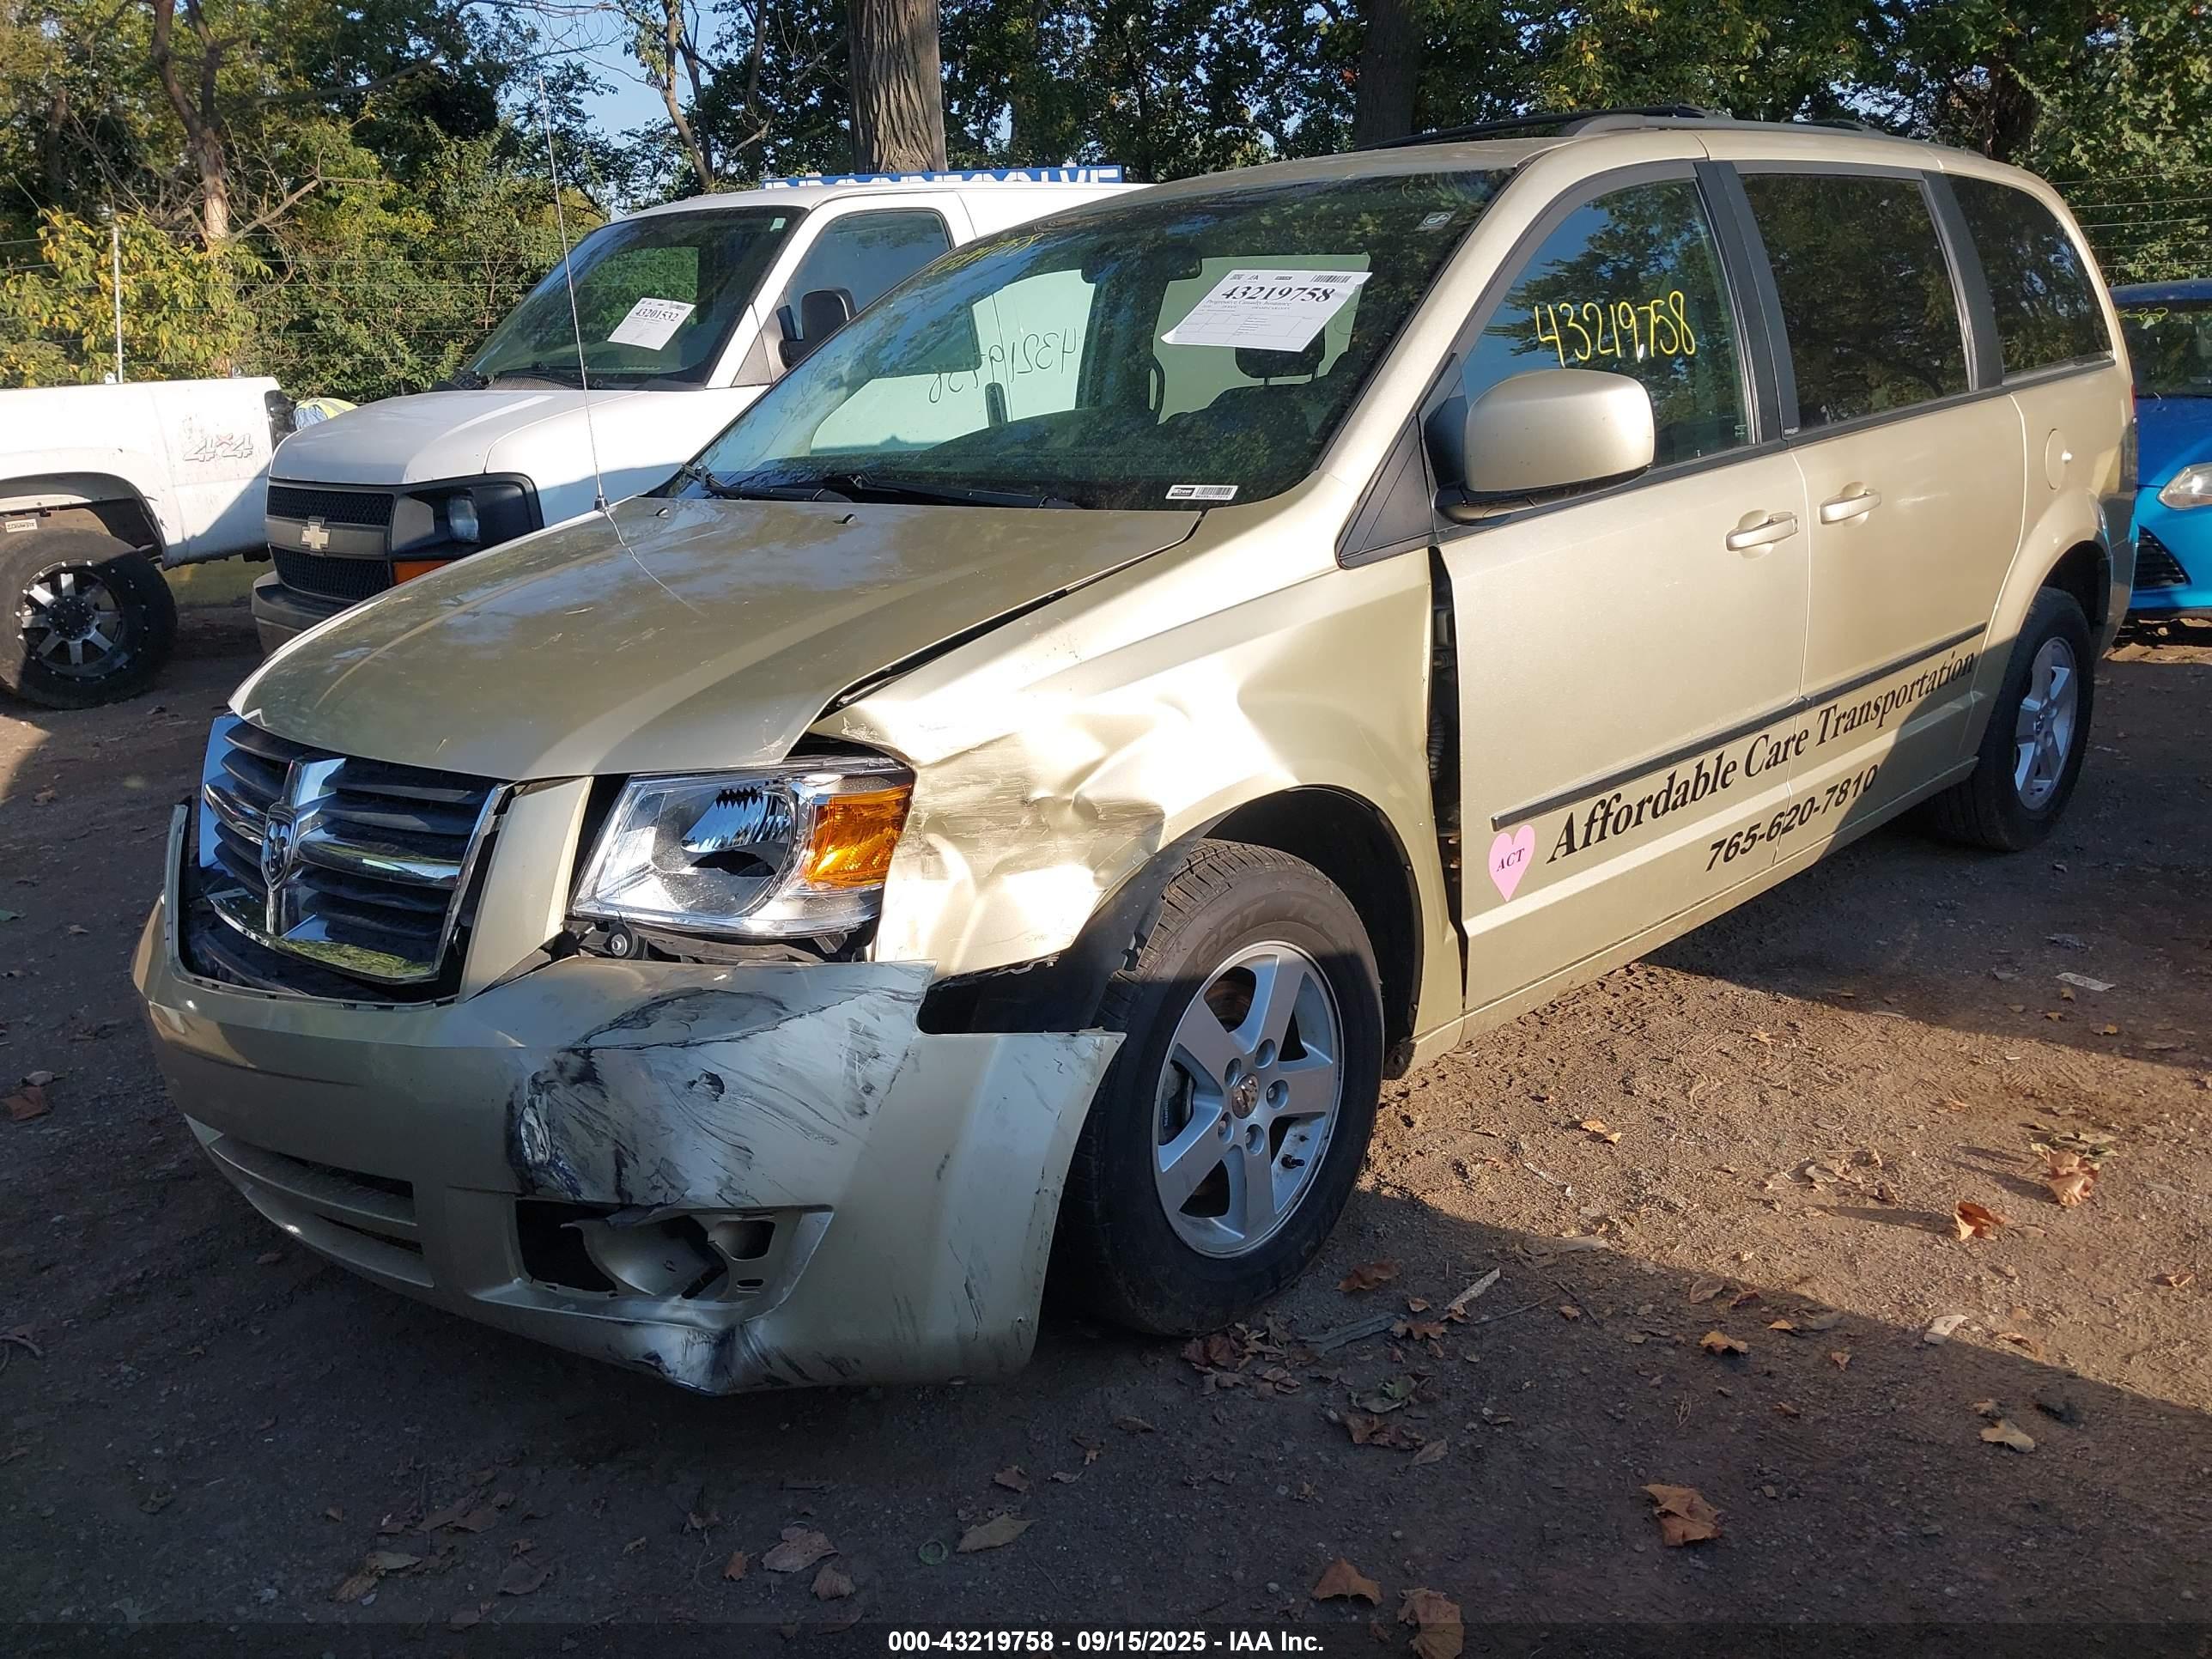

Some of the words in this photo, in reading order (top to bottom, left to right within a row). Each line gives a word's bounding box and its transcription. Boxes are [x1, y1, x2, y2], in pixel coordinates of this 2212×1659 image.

[1221, 286, 1335, 302] 43219758
[1534, 291, 1696, 368] 43219758
[1546, 750, 1736, 864] Affordable
[1745, 728, 1808, 777] Care
[1815, 650, 1974, 746] Transportation
[1705, 763, 1878, 872] 765-620-7810
[1496, 848, 1525, 872] ACT
